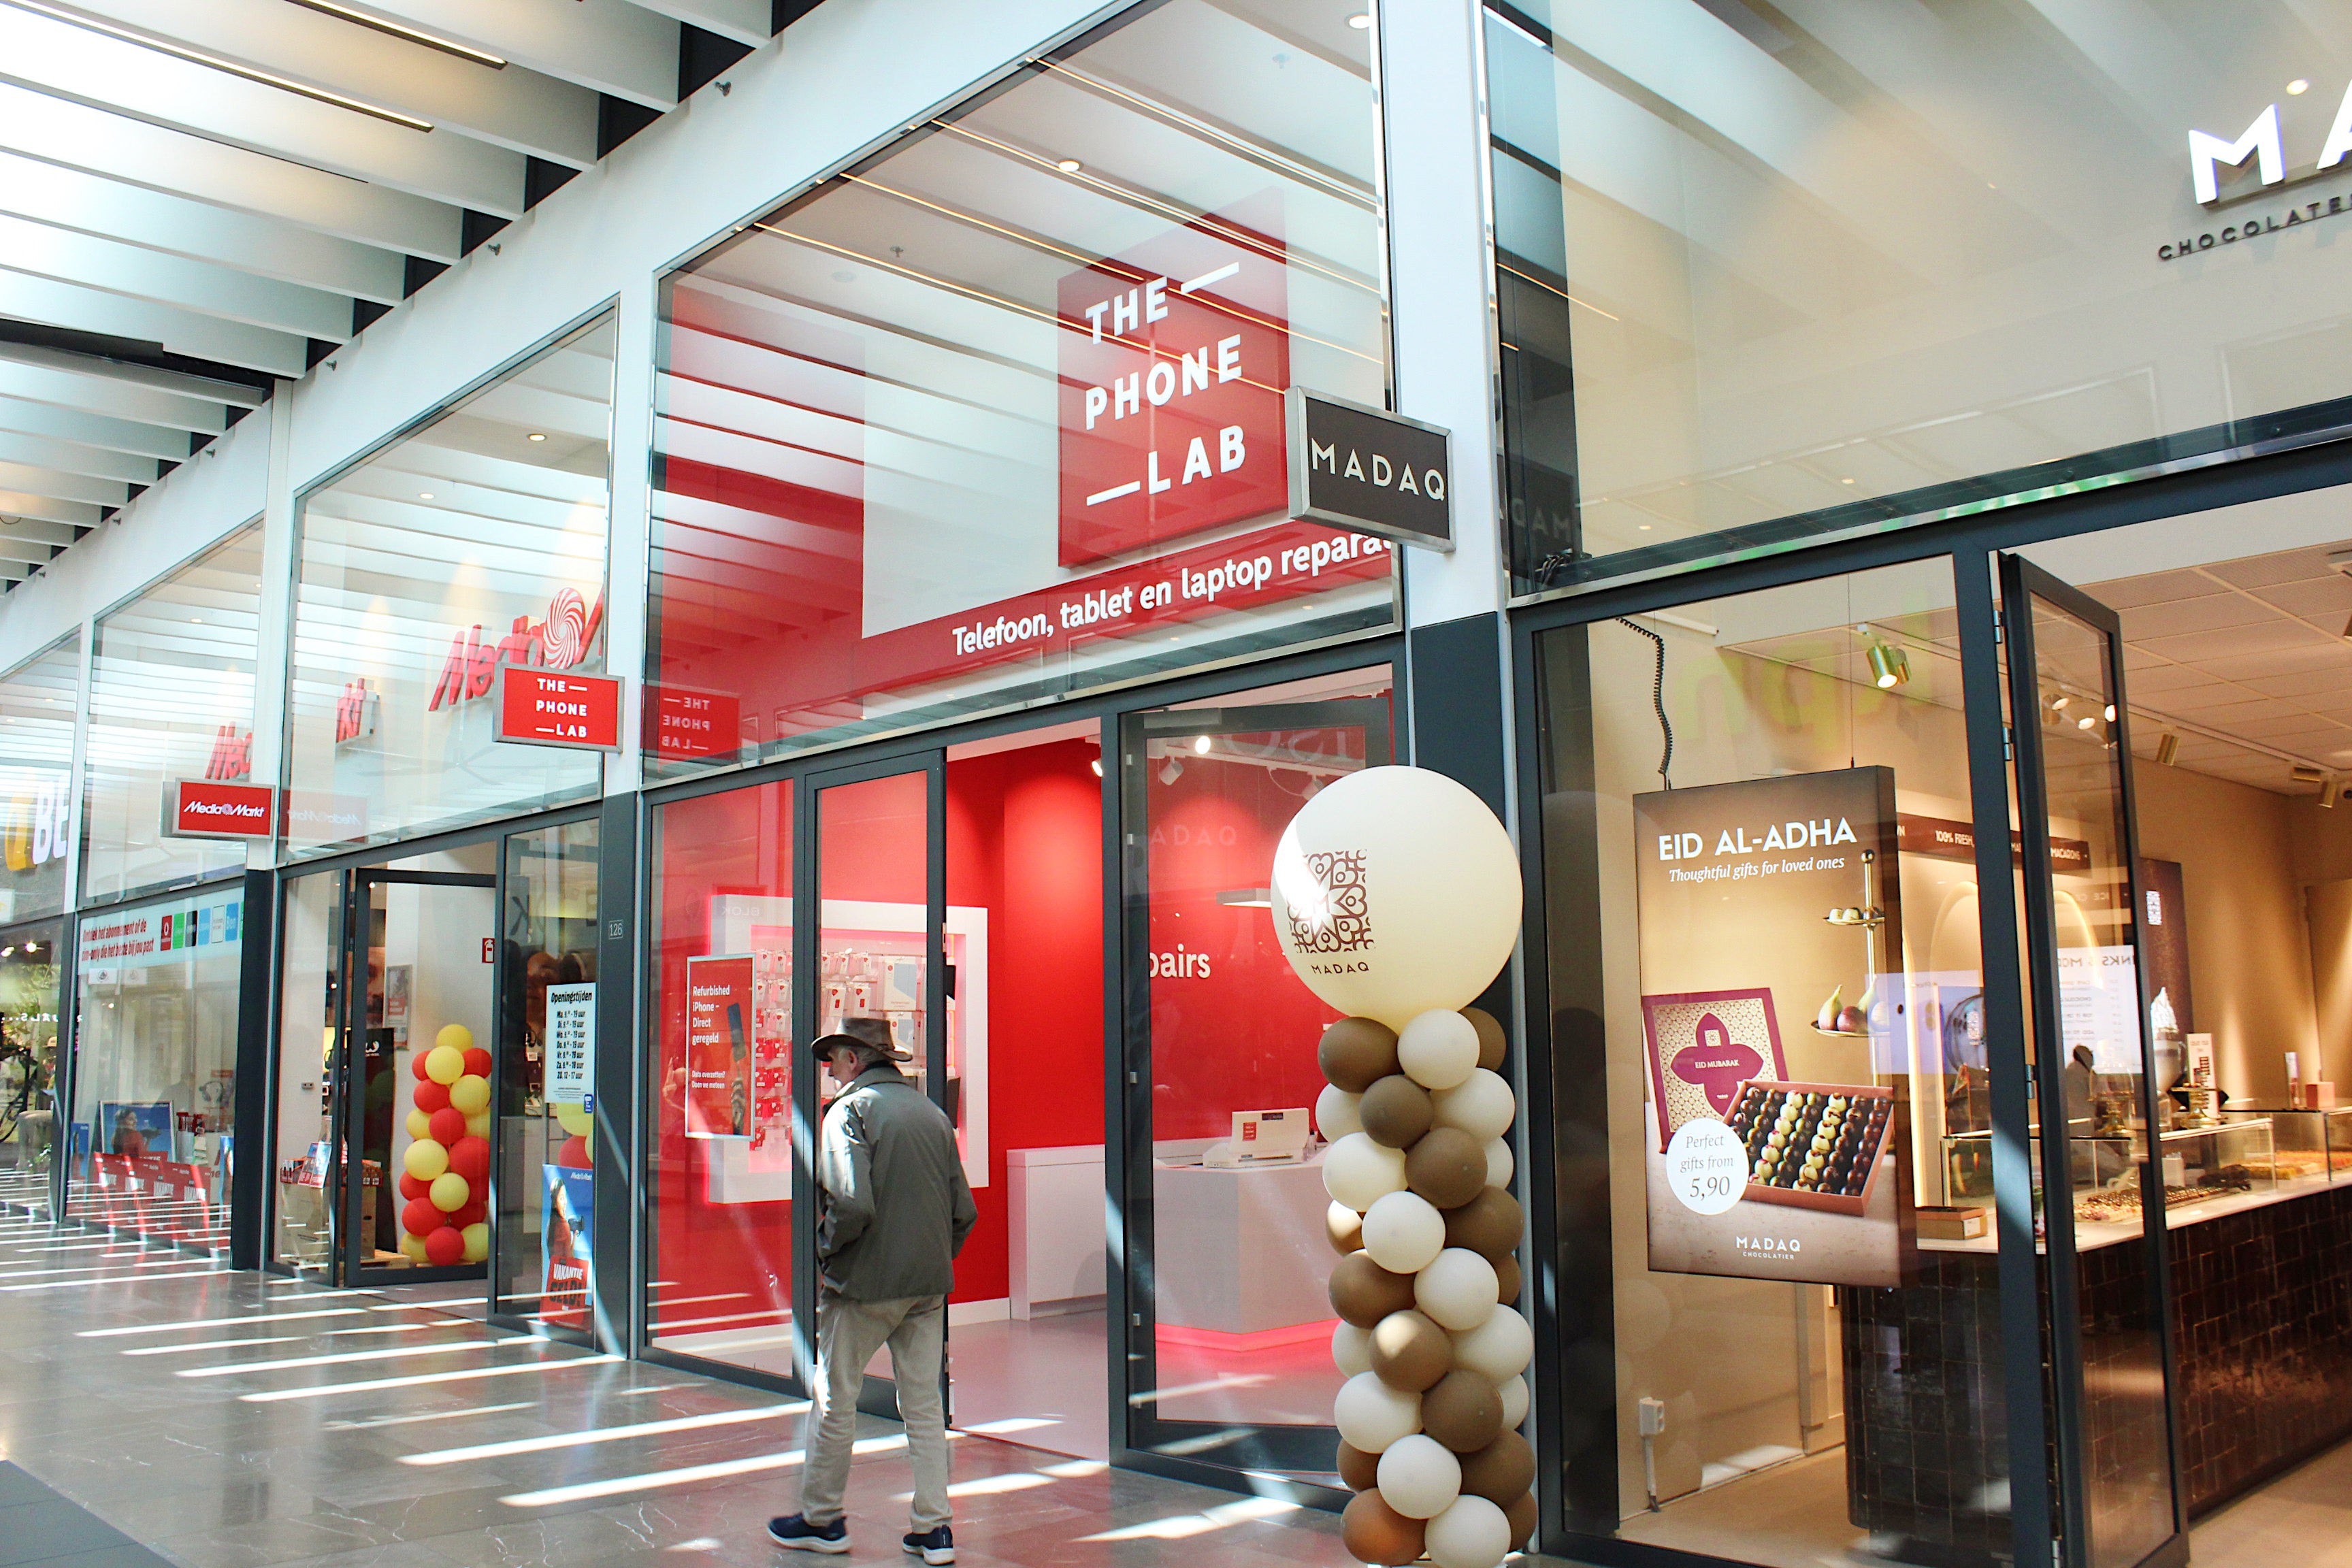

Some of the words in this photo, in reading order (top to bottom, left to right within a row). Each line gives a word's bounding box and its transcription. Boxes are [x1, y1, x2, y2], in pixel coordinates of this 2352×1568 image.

[2158, 193, 2352, 261] CHOCOLATE
[1085, 277, 1169, 345] THE
[1085, 335, 1242, 429] PHONE
[1148, 425, 1245, 495] LAB
[1311, 438, 1445, 501] MADAQ
[953, 613, 1054, 655] Telefoon,
[1060, 583, 1132, 629] tablet
[1139, 579, 1171, 609] en
[1181, 555, 1272, 601] laptop
[1281, 533, 1391, 576] repara
[537, 678, 566, 693] THE
[536, 700, 587, 717] PHONE
[556, 723, 587, 738] LAB
[1659, 832, 1703, 860] EID
[1714, 817, 1857, 855] AL-ADHA
[1669, 864, 1731, 883] Thoughtful
[1733, 862, 1759, 880] gifts
[1761, 861, 1779, 877] for
[1781, 855, 1814, 873] loved
[1816, 858, 1845, 870] ones
[610, 923, 623, 936] 126
[1311, 962, 1369, 974] MADAQ
[551, 990, 592, 1004] Openingstijden
[693, 985, 730, 996] Refurbished
[693, 1001, 715, 1012] iPhone
[693, 1017, 711, 1028] Direct
[692, 1032, 719, 1046] geregeld
[1707, 1059, 1740, 1068] MUBARAK
[1686, 1134, 1725, 1150] Perfect
[1680, 1156, 1705, 1173] gifts
[1707, 1155, 1734, 1171] from
[1690, 1176, 1730, 1201] 5,90
[1736, 1236, 1801, 1252] MADAQ
[1742, 1250, 1795, 1260] CHOCOLATIER
[554, 1264, 583, 1279] VAKANTIE
